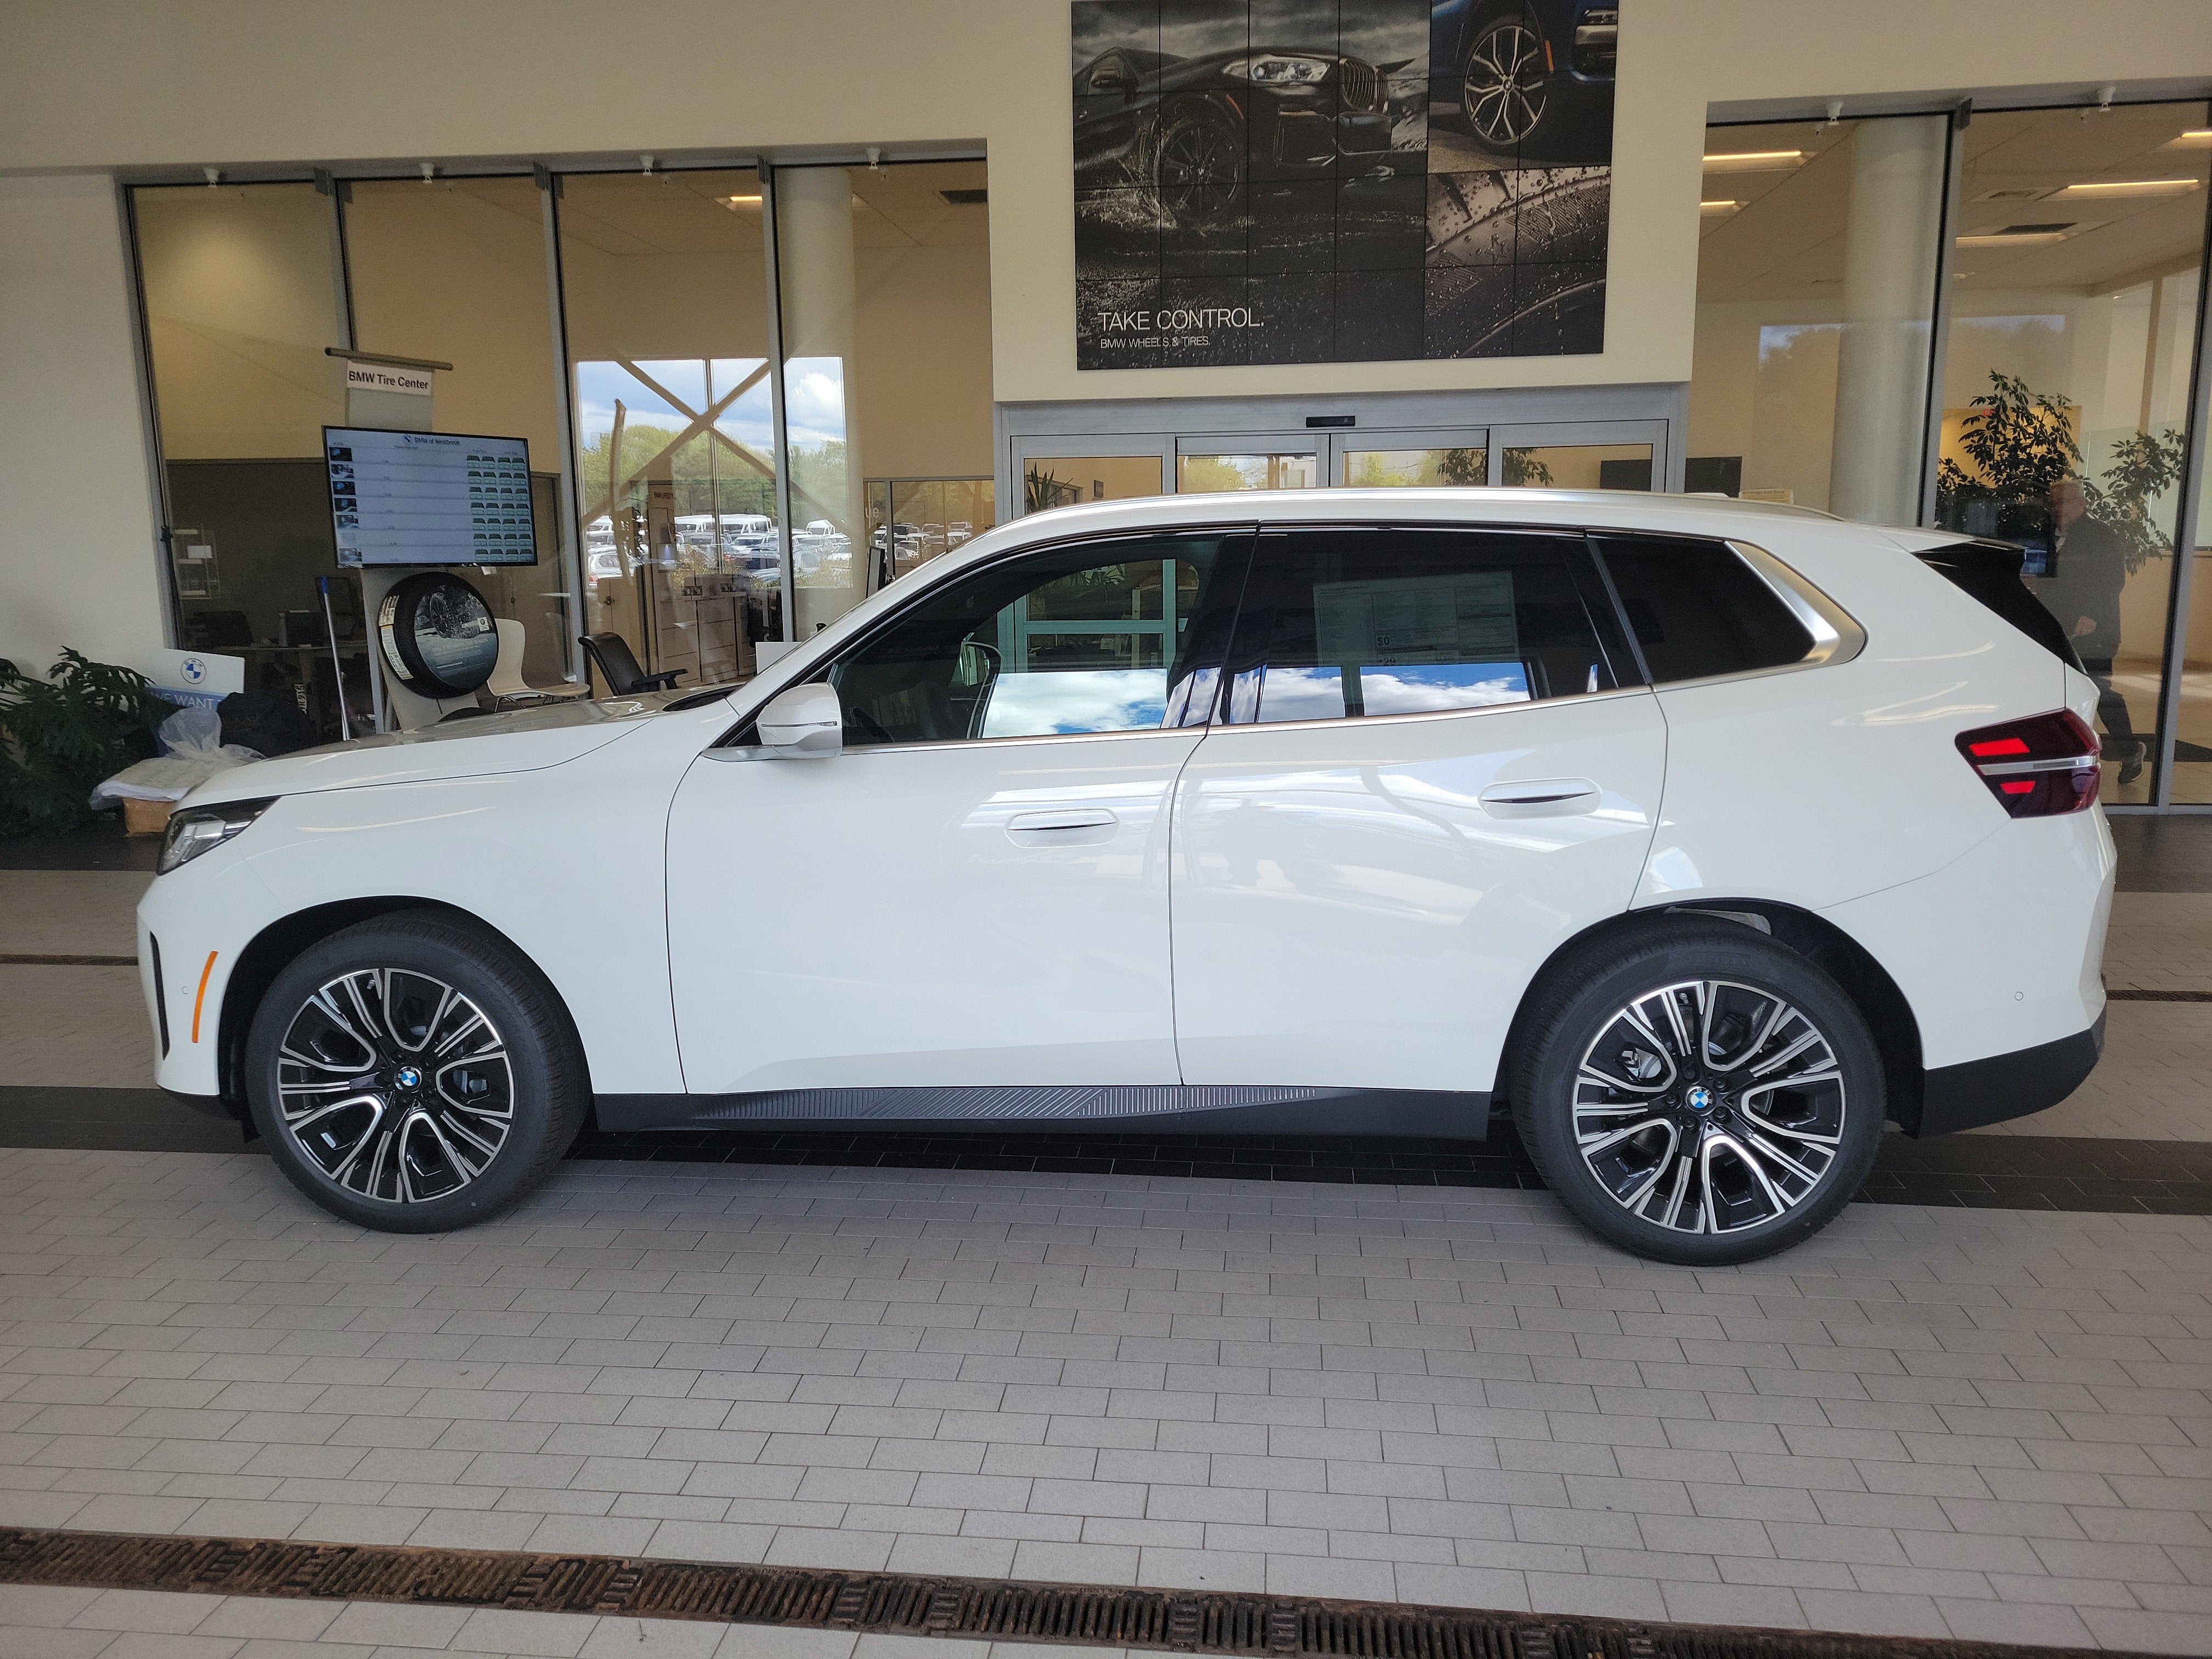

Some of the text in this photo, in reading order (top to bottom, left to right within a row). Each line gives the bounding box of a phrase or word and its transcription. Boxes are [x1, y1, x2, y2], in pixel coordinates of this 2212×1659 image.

[1098, 307, 1264, 331] TAKE CONTROL.
[1101, 338, 1127, 349] BMW
[1172, 337, 1179, 347] &
[349, 371, 428, 389] BMW Tire Center
[174, 695, 214, 710] WANT
